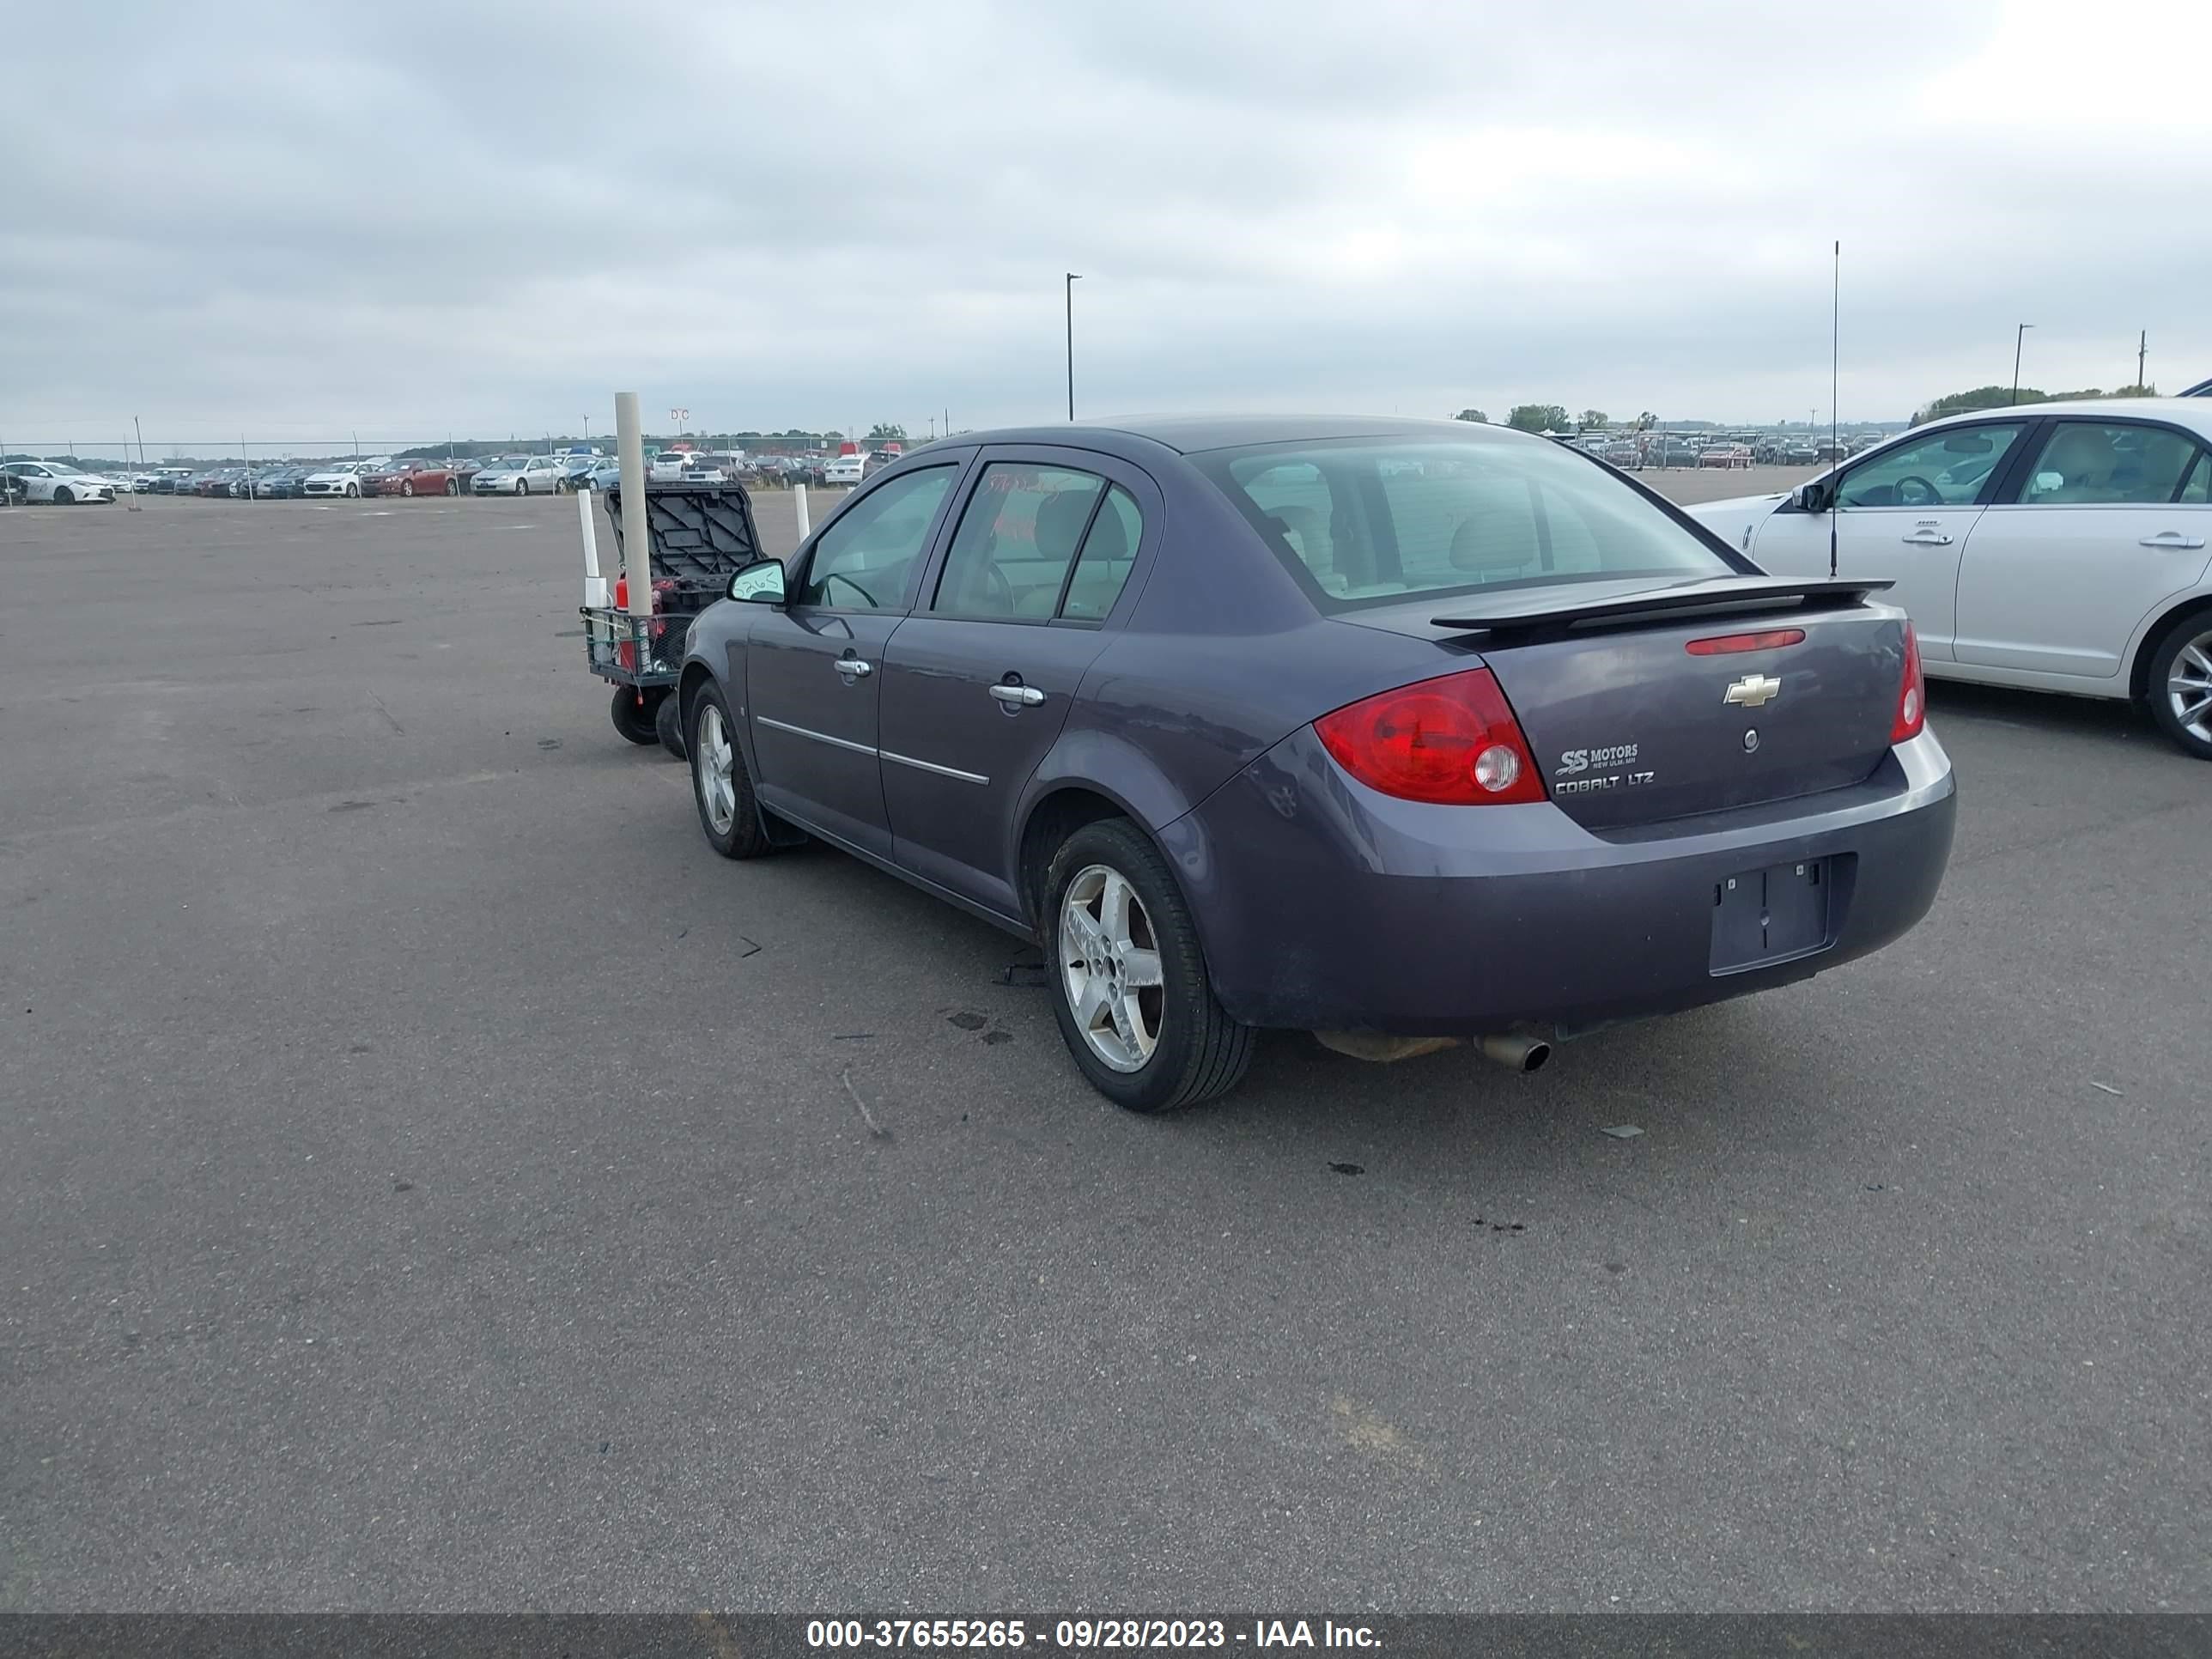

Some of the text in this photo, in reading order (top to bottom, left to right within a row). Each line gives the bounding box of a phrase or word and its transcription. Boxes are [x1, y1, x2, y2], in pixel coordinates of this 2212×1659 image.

[1555, 744, 1638, 775] SS MOTORS
[1555, 771, 1655, 795] COBALT LTZ
